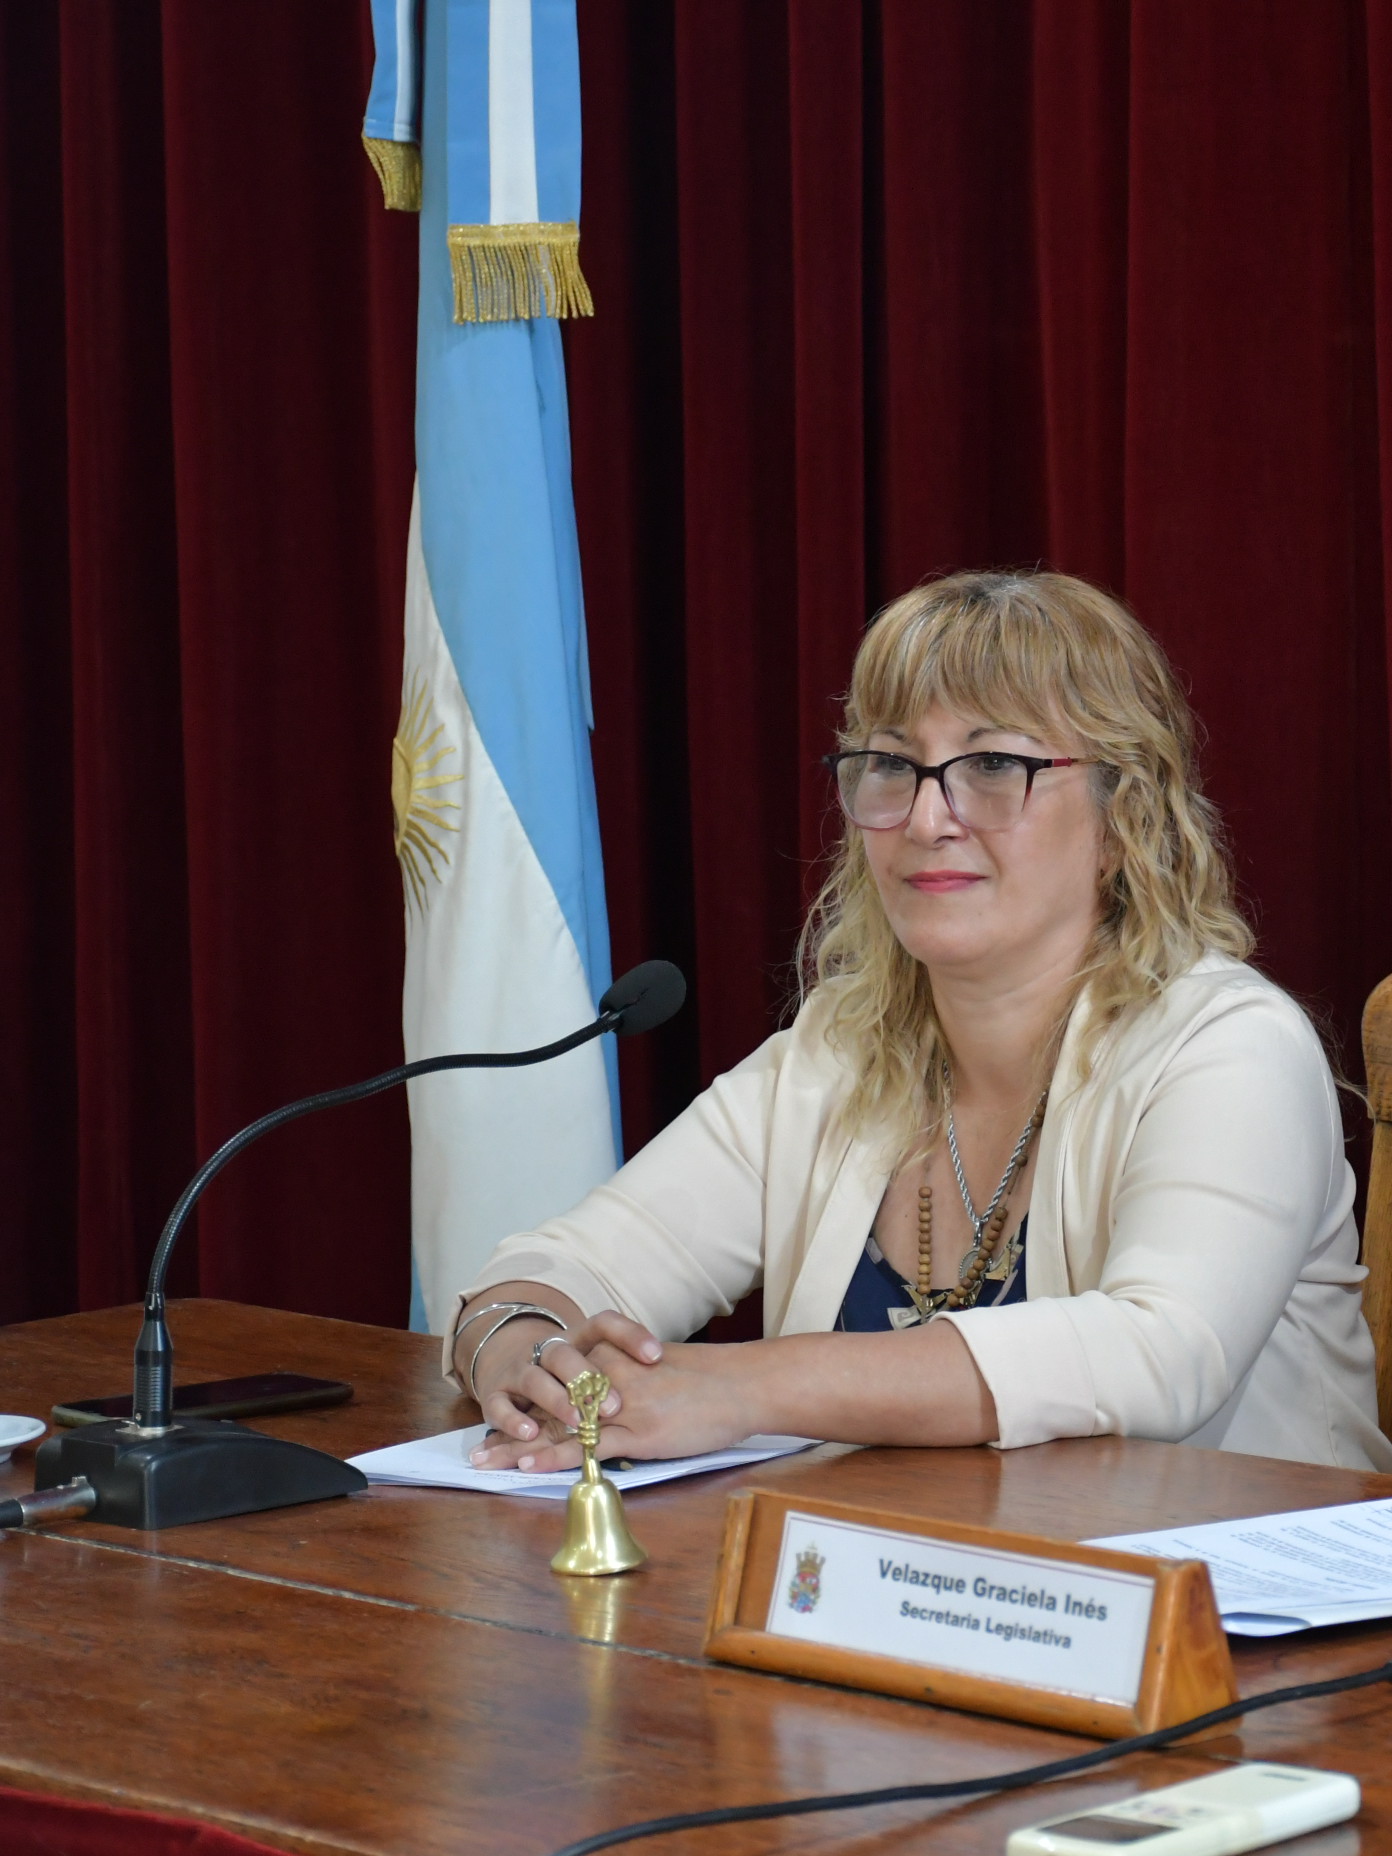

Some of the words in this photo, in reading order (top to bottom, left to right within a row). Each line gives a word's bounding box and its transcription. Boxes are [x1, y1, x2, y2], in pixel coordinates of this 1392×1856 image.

[878, 1558, 967, 1595] Velazque
[973, 1577, 1057, 1612] Graciela
[1064, 1593, 1108, 1622] Inés
[900, 1600, 980, 1631] Secretaria
[985, 1617, 1072, 1650] Legislativa
